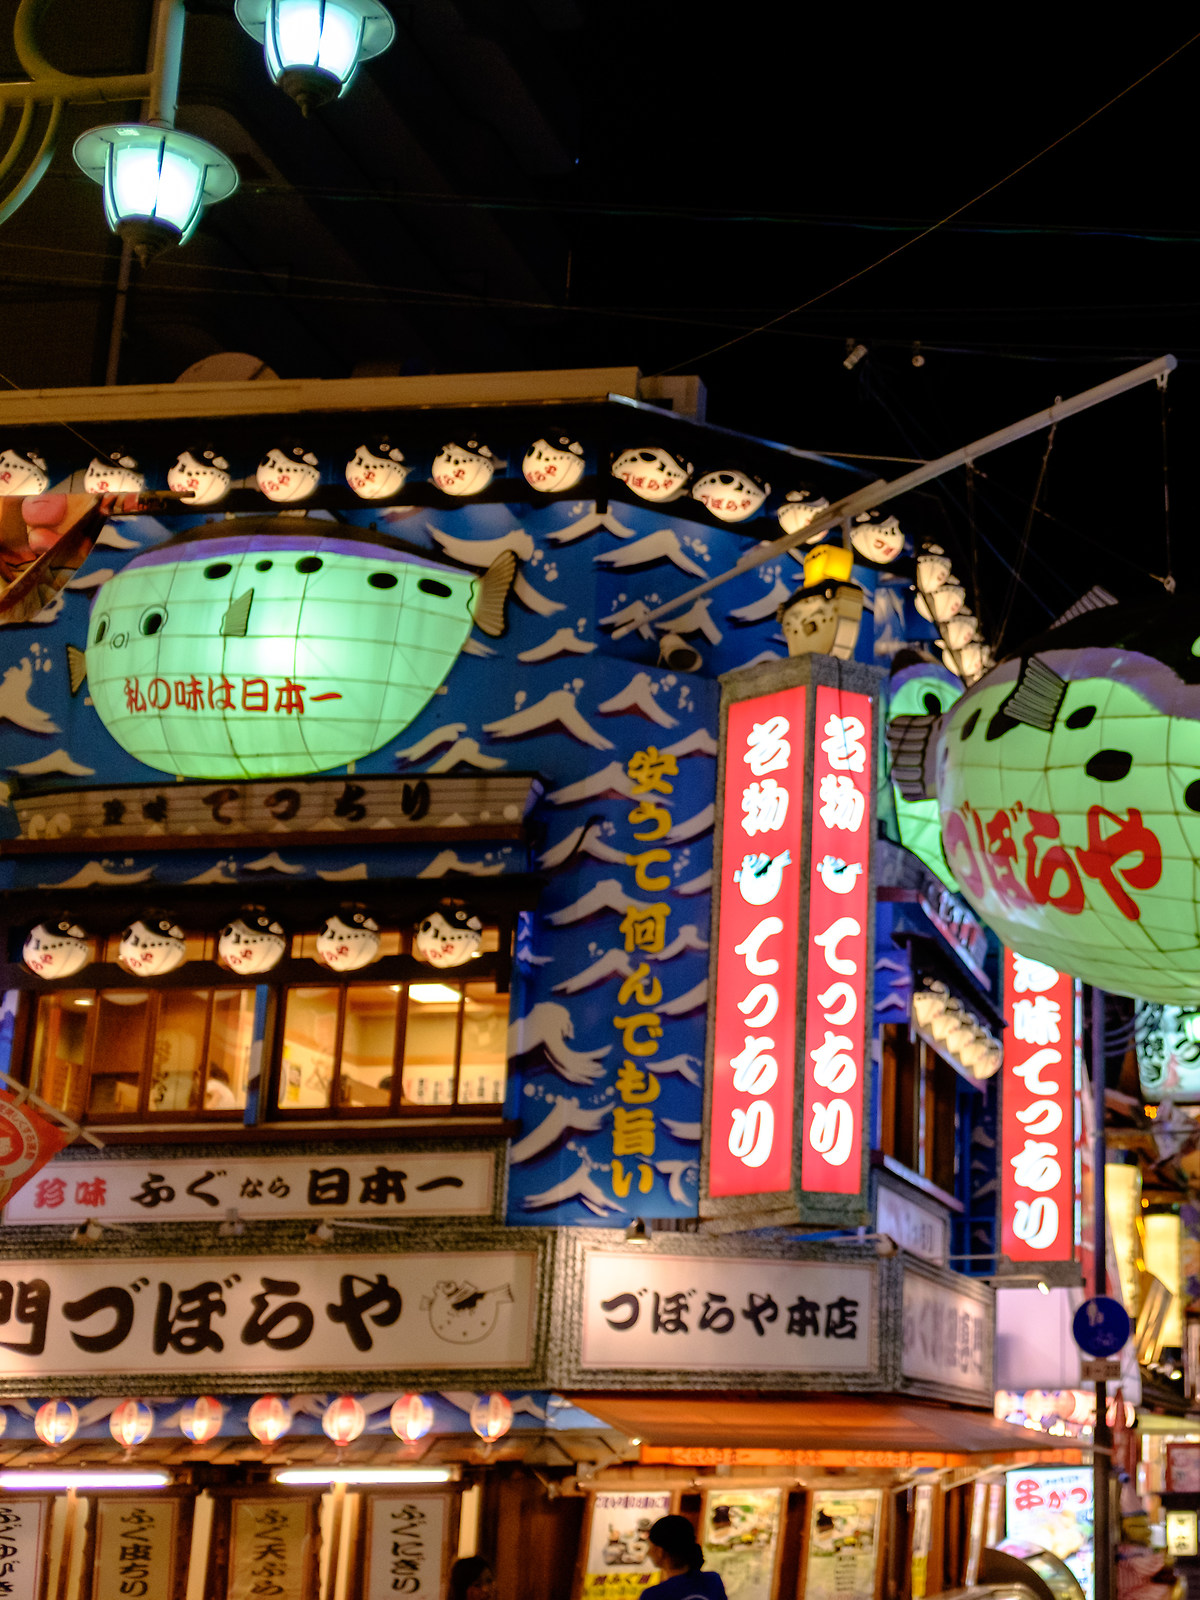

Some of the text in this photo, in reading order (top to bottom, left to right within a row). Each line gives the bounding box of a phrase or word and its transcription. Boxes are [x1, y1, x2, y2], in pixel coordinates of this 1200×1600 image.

[124, 676, 342, 715] 私の味は日本一
[741, 715, 791, 836] 名物
[819, 713, 866, 832] 名物
[612, 745, 679, 1198] 安うて何んでも旨い
[34, 1177, 106, 1208] 珍味
[601, 1288, 859, 1339] づぼらや本店
[1015, 1479, 1088, 1511] 串かつ
